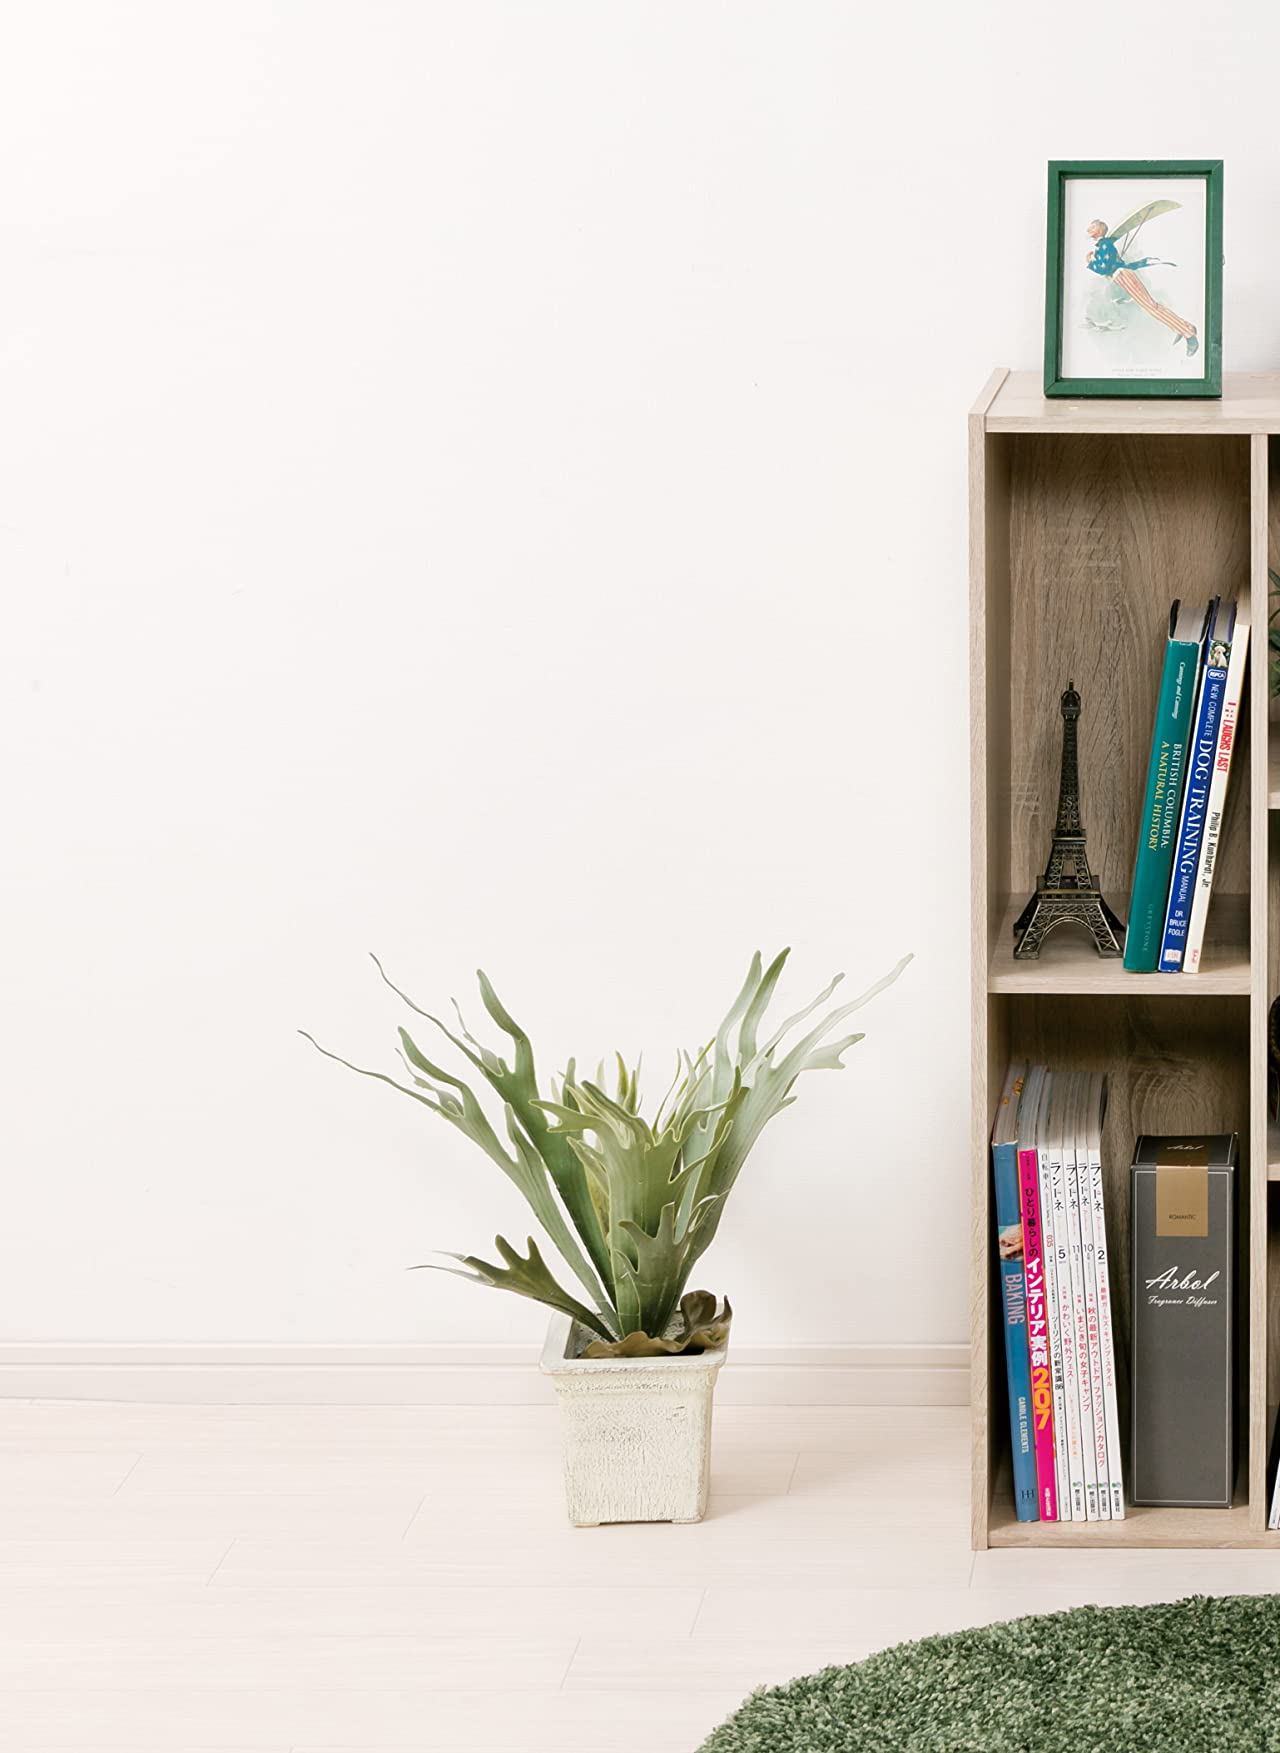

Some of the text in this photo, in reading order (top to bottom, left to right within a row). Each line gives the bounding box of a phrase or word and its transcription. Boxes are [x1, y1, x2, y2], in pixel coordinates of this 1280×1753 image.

[1220, 720, 1235, 751] LAUGHS
[1216, 752, 1230, 773] LAST
[1148, 741, 1170, 851] A NATURAL HISTORY
[1161, 743, 1182, 848] BRITISH COLUMBIA:
[1178, 683, 1220, 903] NEW COMPLETE DOG TRAINING MANUAL
[1209, 811, 1220, 831] Philip
[1208, 832, 1218, 841] B.
[1169, 918, 1187, 927] BRUCE
[1168, 929, 1185, 937] FOGLE
[1058, 1249, 1066, 1259] 5
[1072, 1245, 1080, 1254] 11
[1084, 1243, 1094, 1252] 10
[1097, 1250, 1105, 1260] 2
[1145, 1265, 1220, 1290] Arbol
[1005, 1273, 1025, 1325] BAKING
[1148, 1296, 1217, 1307] Fragrance Diffuser
[1018, 1397, 1029, 1454] CAROLE CLEMENTS
